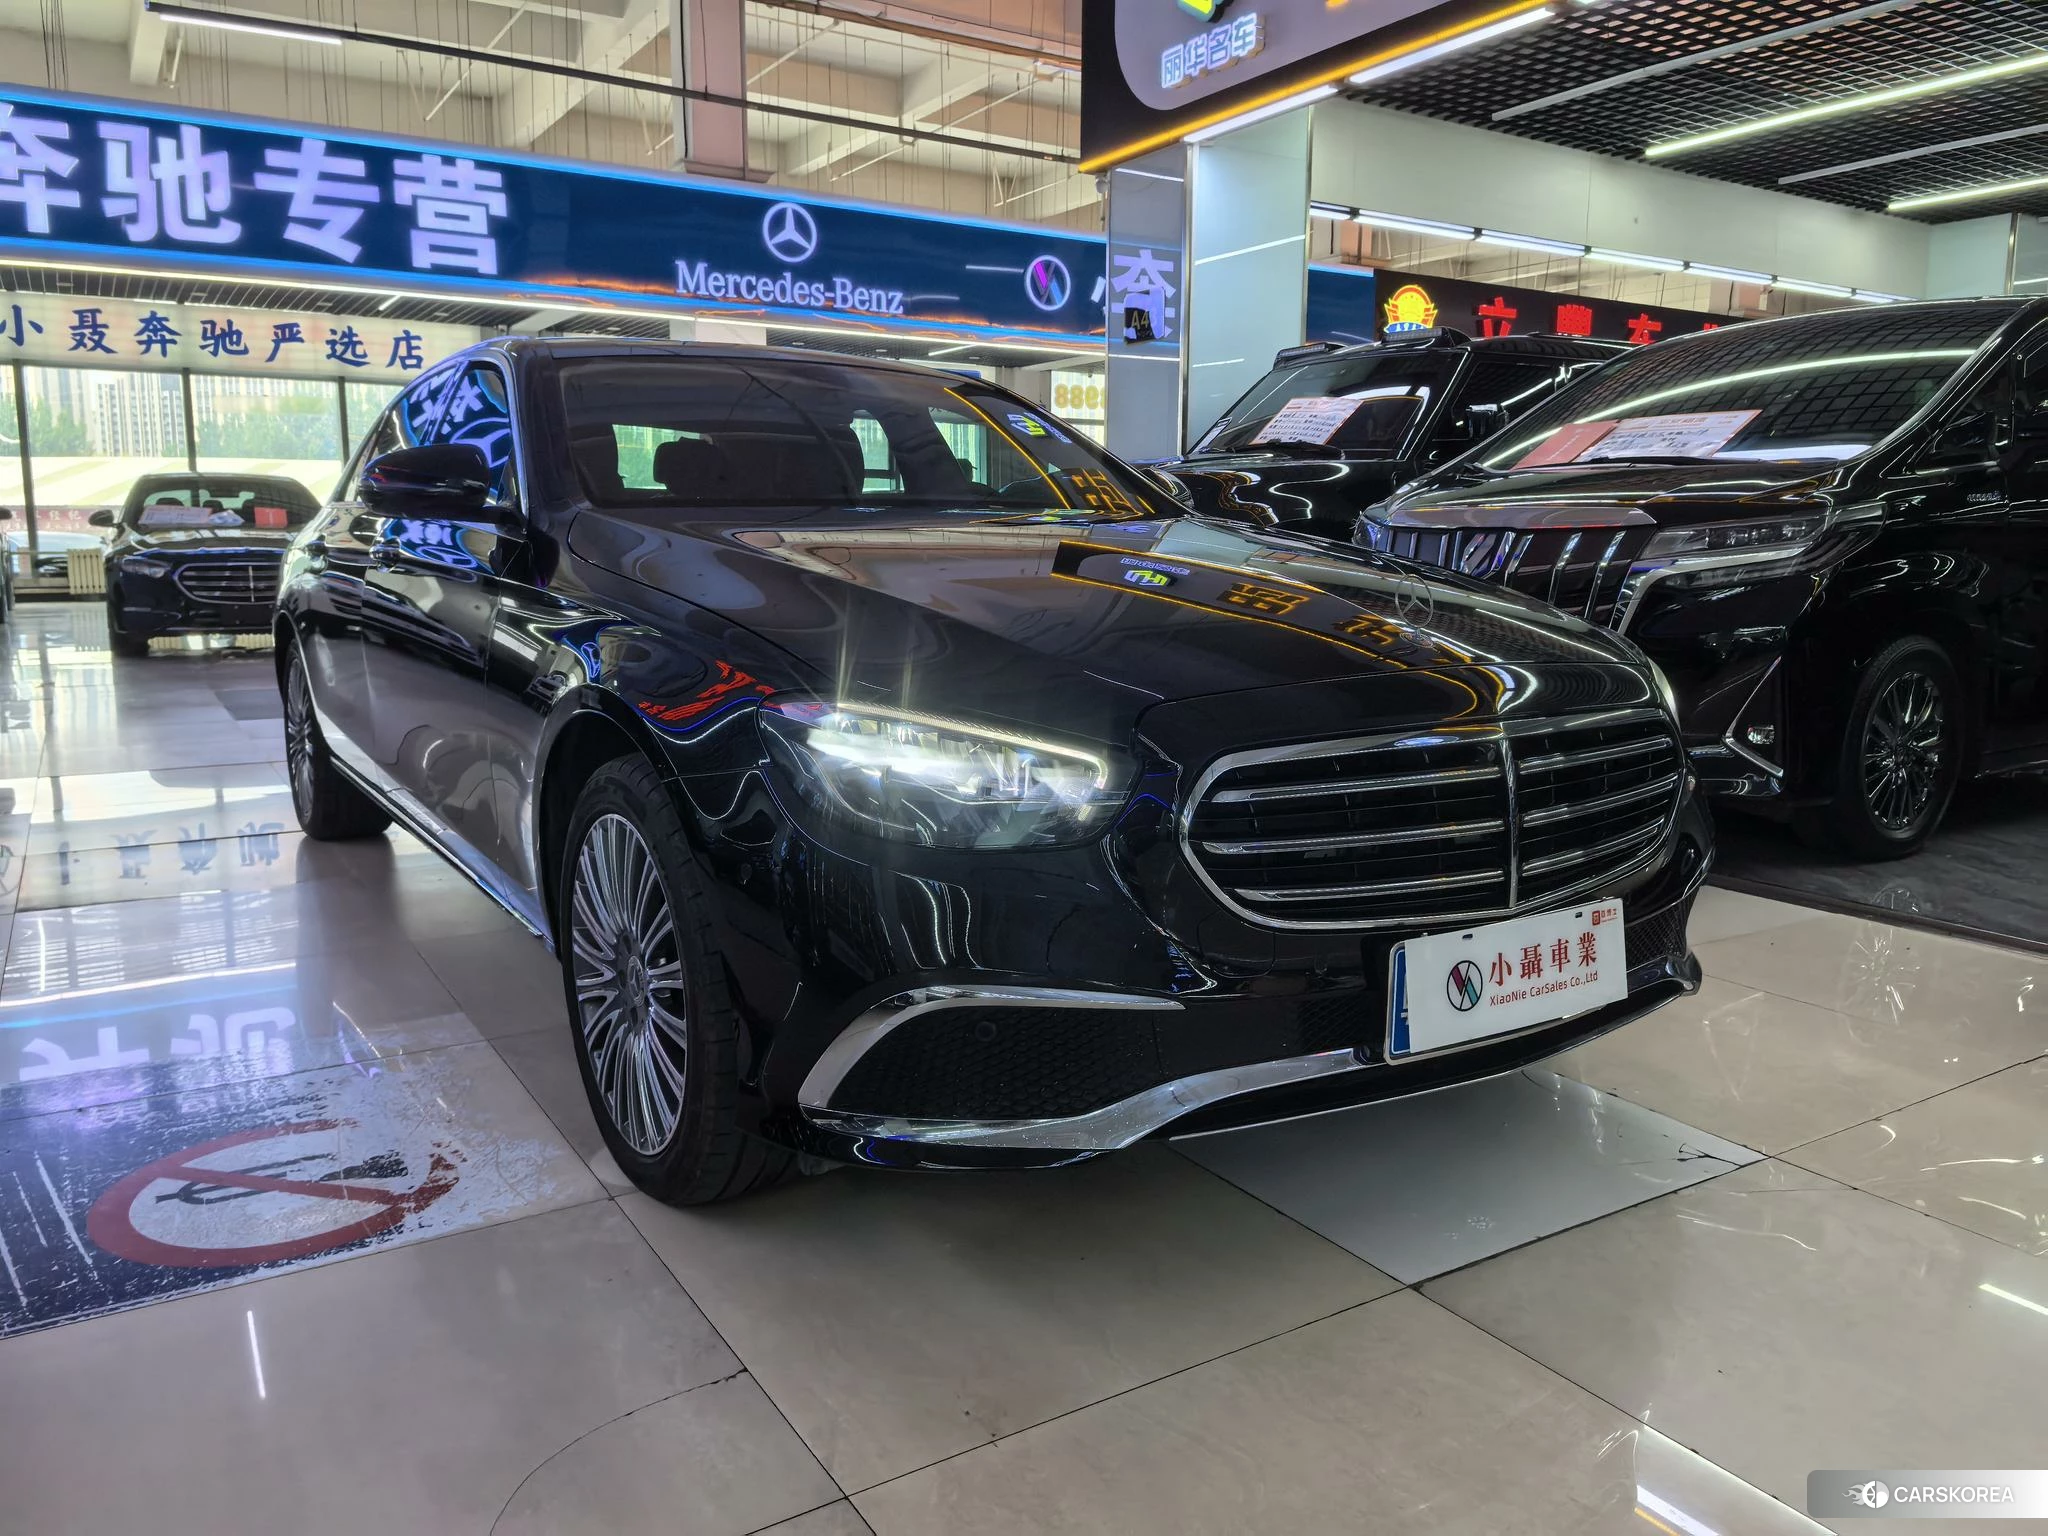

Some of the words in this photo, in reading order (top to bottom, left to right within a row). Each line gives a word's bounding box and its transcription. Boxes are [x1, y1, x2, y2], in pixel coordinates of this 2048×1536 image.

[1161, 12, 1257, 89] 丽华名车
[0, 102, 509, 277] 奔驰专营
[675, 260, 904, 314] Mercedes-Benz
[0, 303, 425, 370] 小聂奔驰严选店
[1131, 310, 1150, 330] A4
[1488, 931, 1597, 987] 小聶車業
[1490, 989, 1527, 1007] XiaoNie
[1530, 979, 1568, 997] CarSales
[1570, 970, 1598, 987] Co.,Ltd
